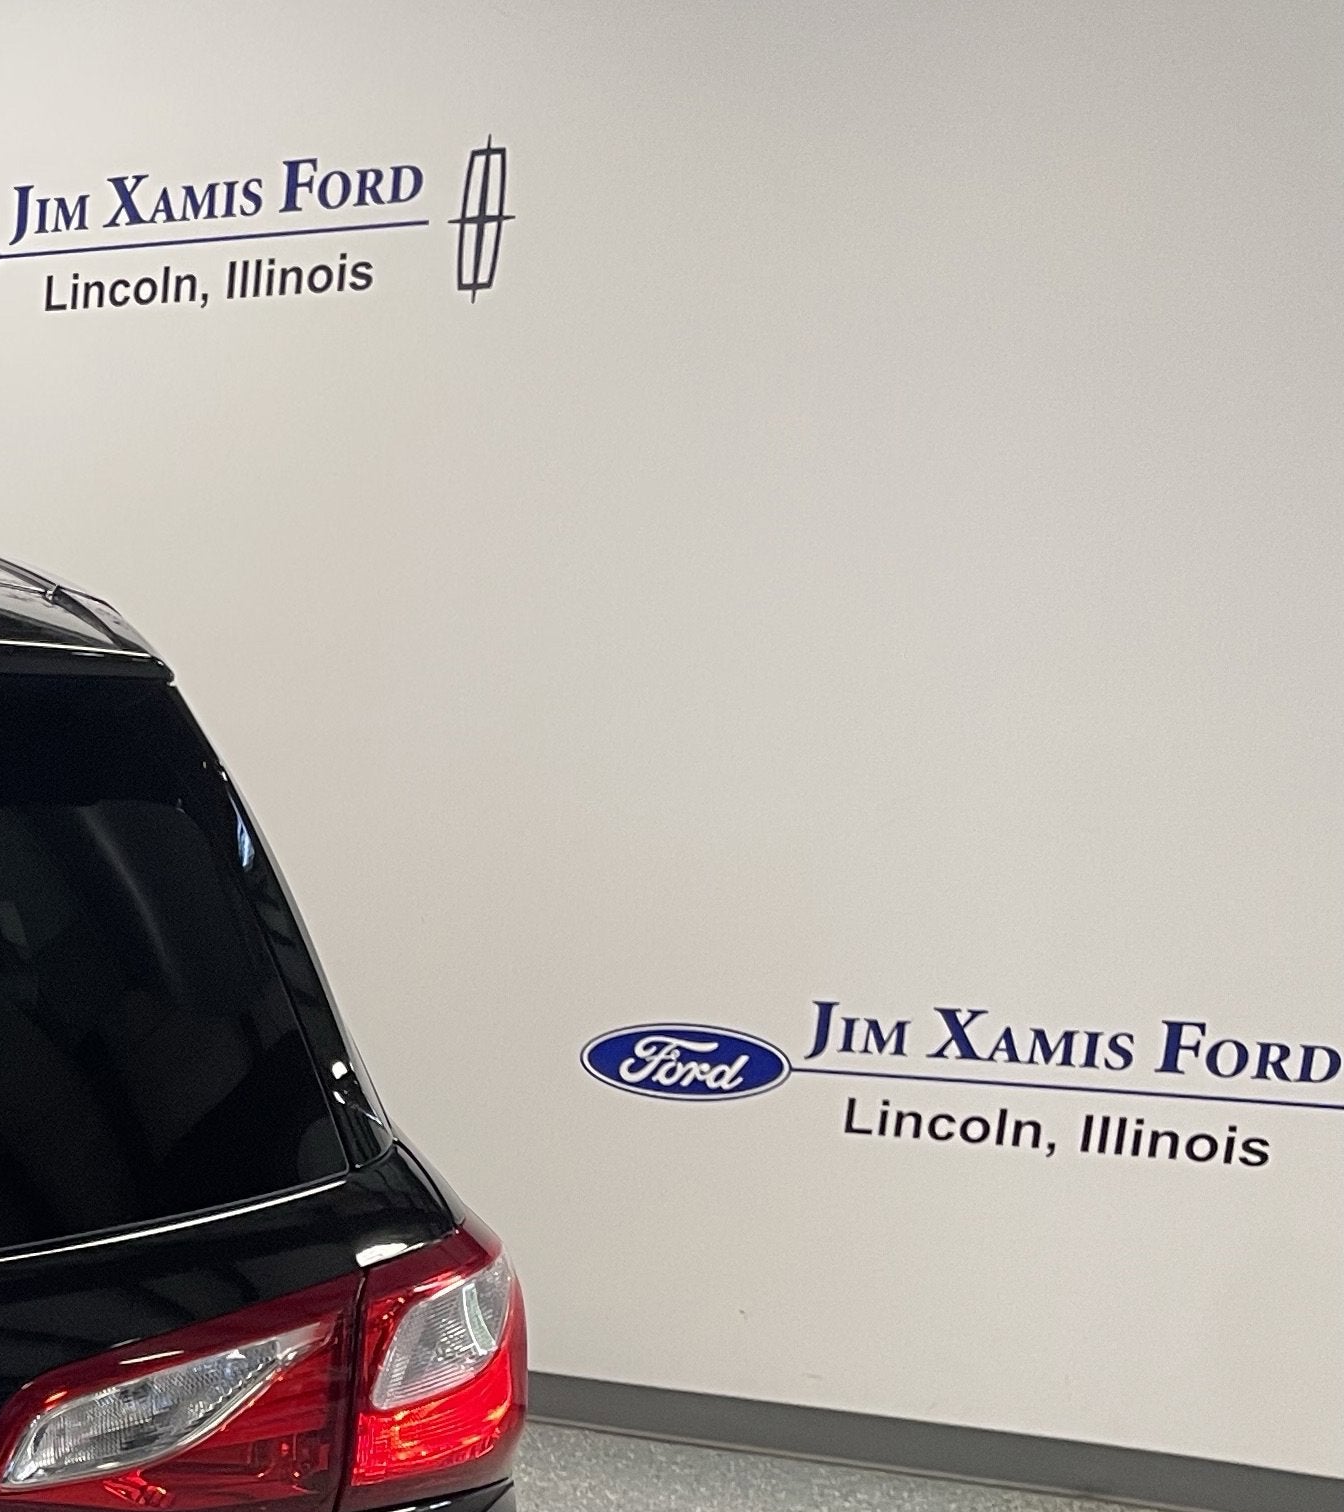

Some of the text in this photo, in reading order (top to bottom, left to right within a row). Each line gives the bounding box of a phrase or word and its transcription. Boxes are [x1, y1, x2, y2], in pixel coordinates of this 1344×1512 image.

[9, 157, 424, 246] JIM XAMIS FORD
[44, 253, 375, 313] Lincoln, Illinois
[619, 1034, 750, 1092] Ford
[803, 1000, 1342, 1085] JIM XAMIS FORD
[843, 1096, 1271, 1168] Lincoln, Illinois
